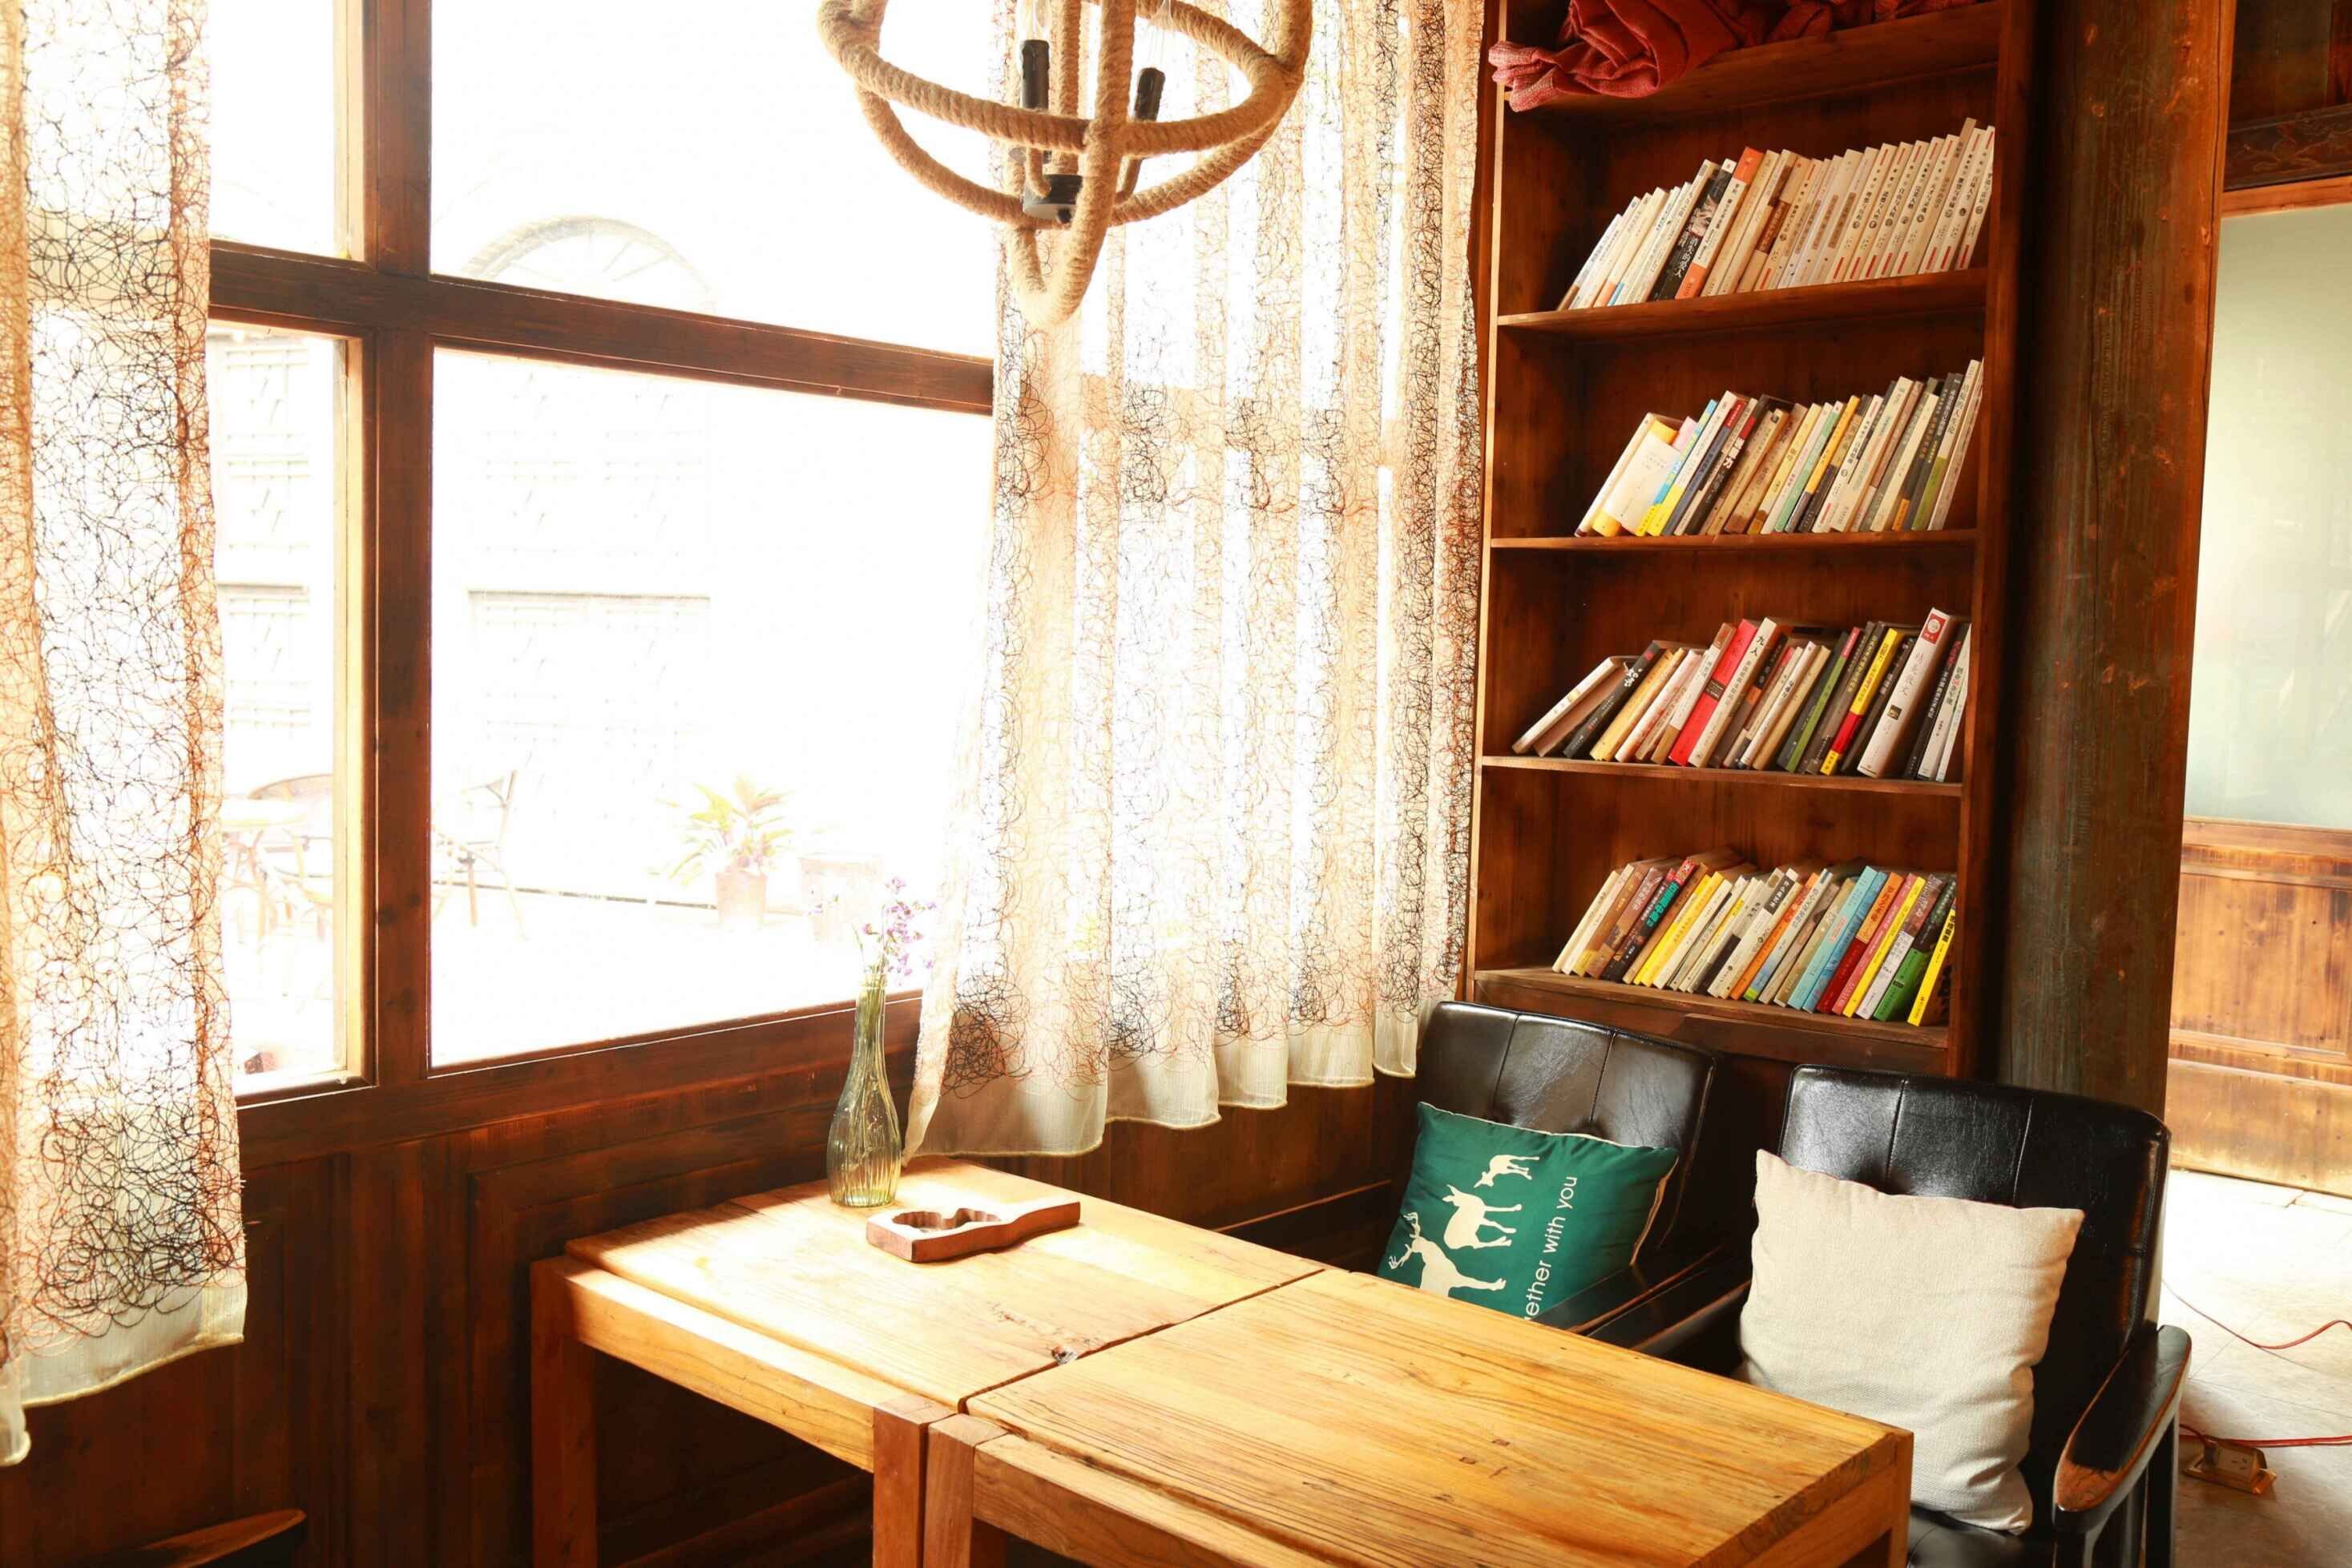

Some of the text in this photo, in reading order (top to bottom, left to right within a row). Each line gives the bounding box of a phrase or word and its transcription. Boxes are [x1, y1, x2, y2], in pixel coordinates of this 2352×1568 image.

[1524, 1175, 1578, 1320] ether with you
